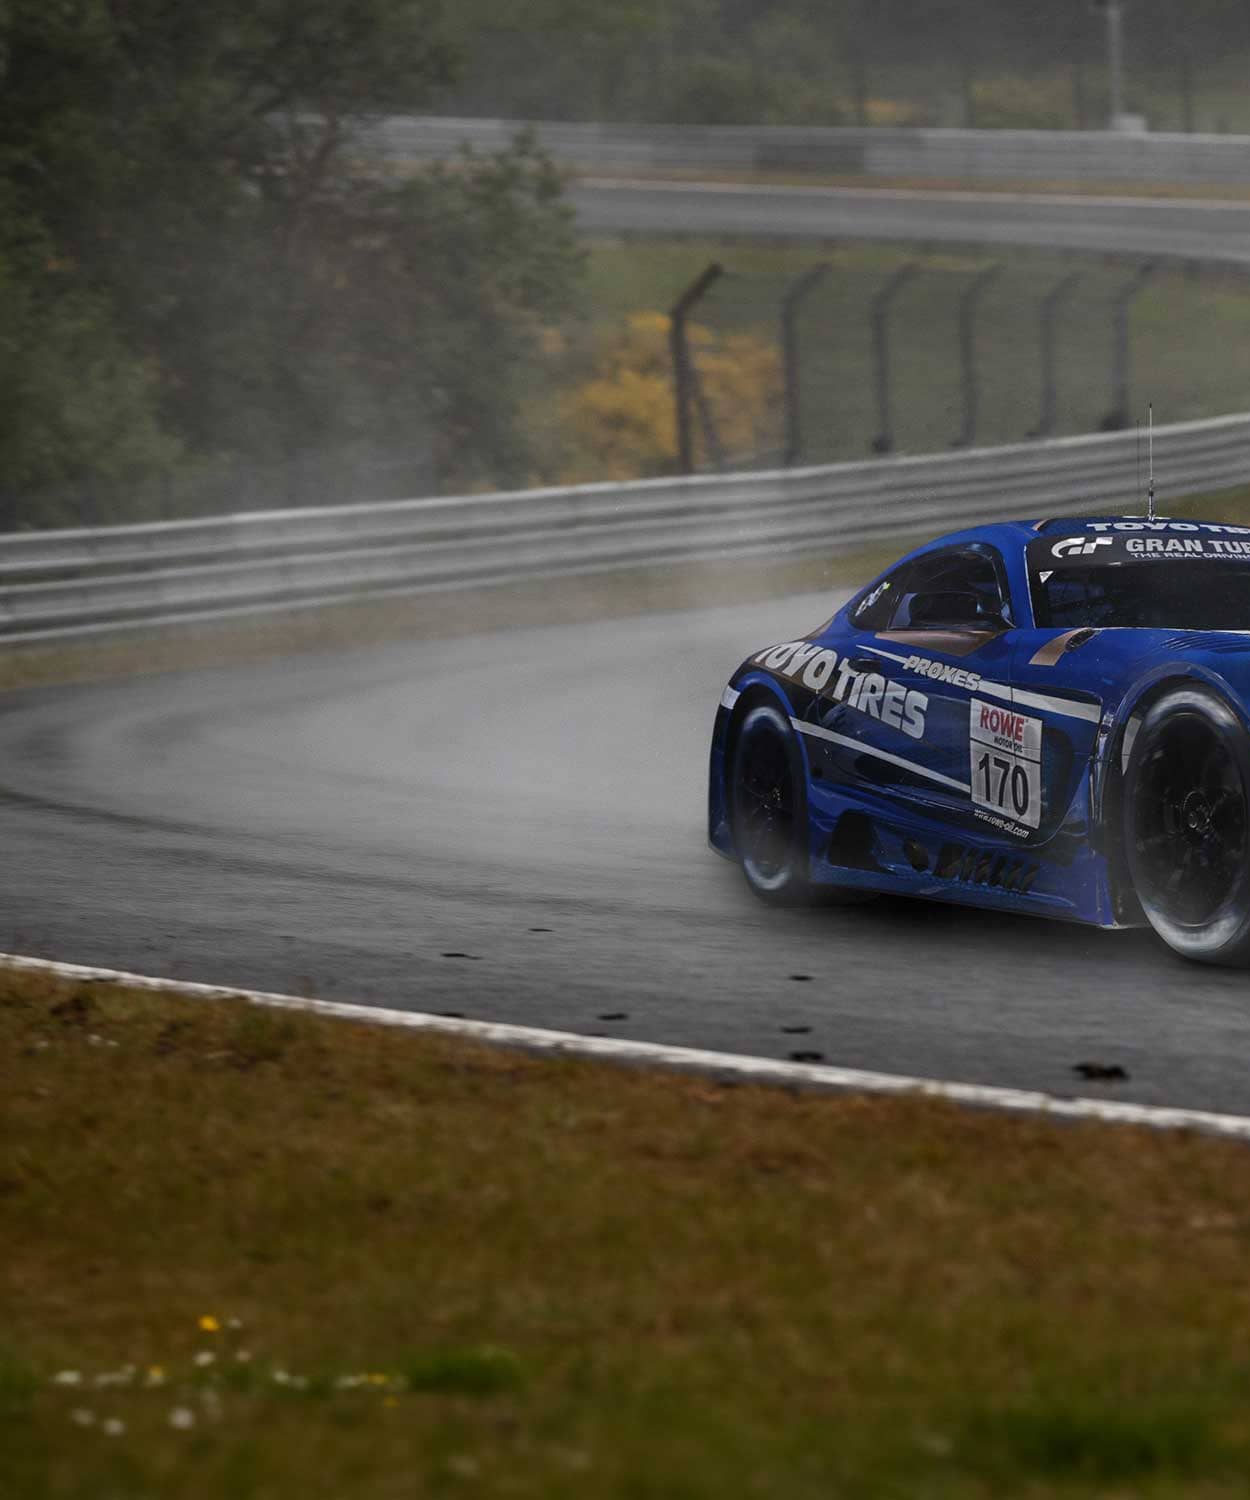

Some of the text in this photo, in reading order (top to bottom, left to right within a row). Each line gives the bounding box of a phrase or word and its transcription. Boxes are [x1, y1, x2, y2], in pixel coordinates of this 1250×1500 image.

[1086, 522, 1199, 531] TOYO
[1126, 538, 1203, 552] GRAN
[754, 641, 928, 739] TOYO TIRES
[902, 655, 982, 691] PROXES
[979, 704, 1025, 742] ROWE
[978, 752, 1029, 816] 170
